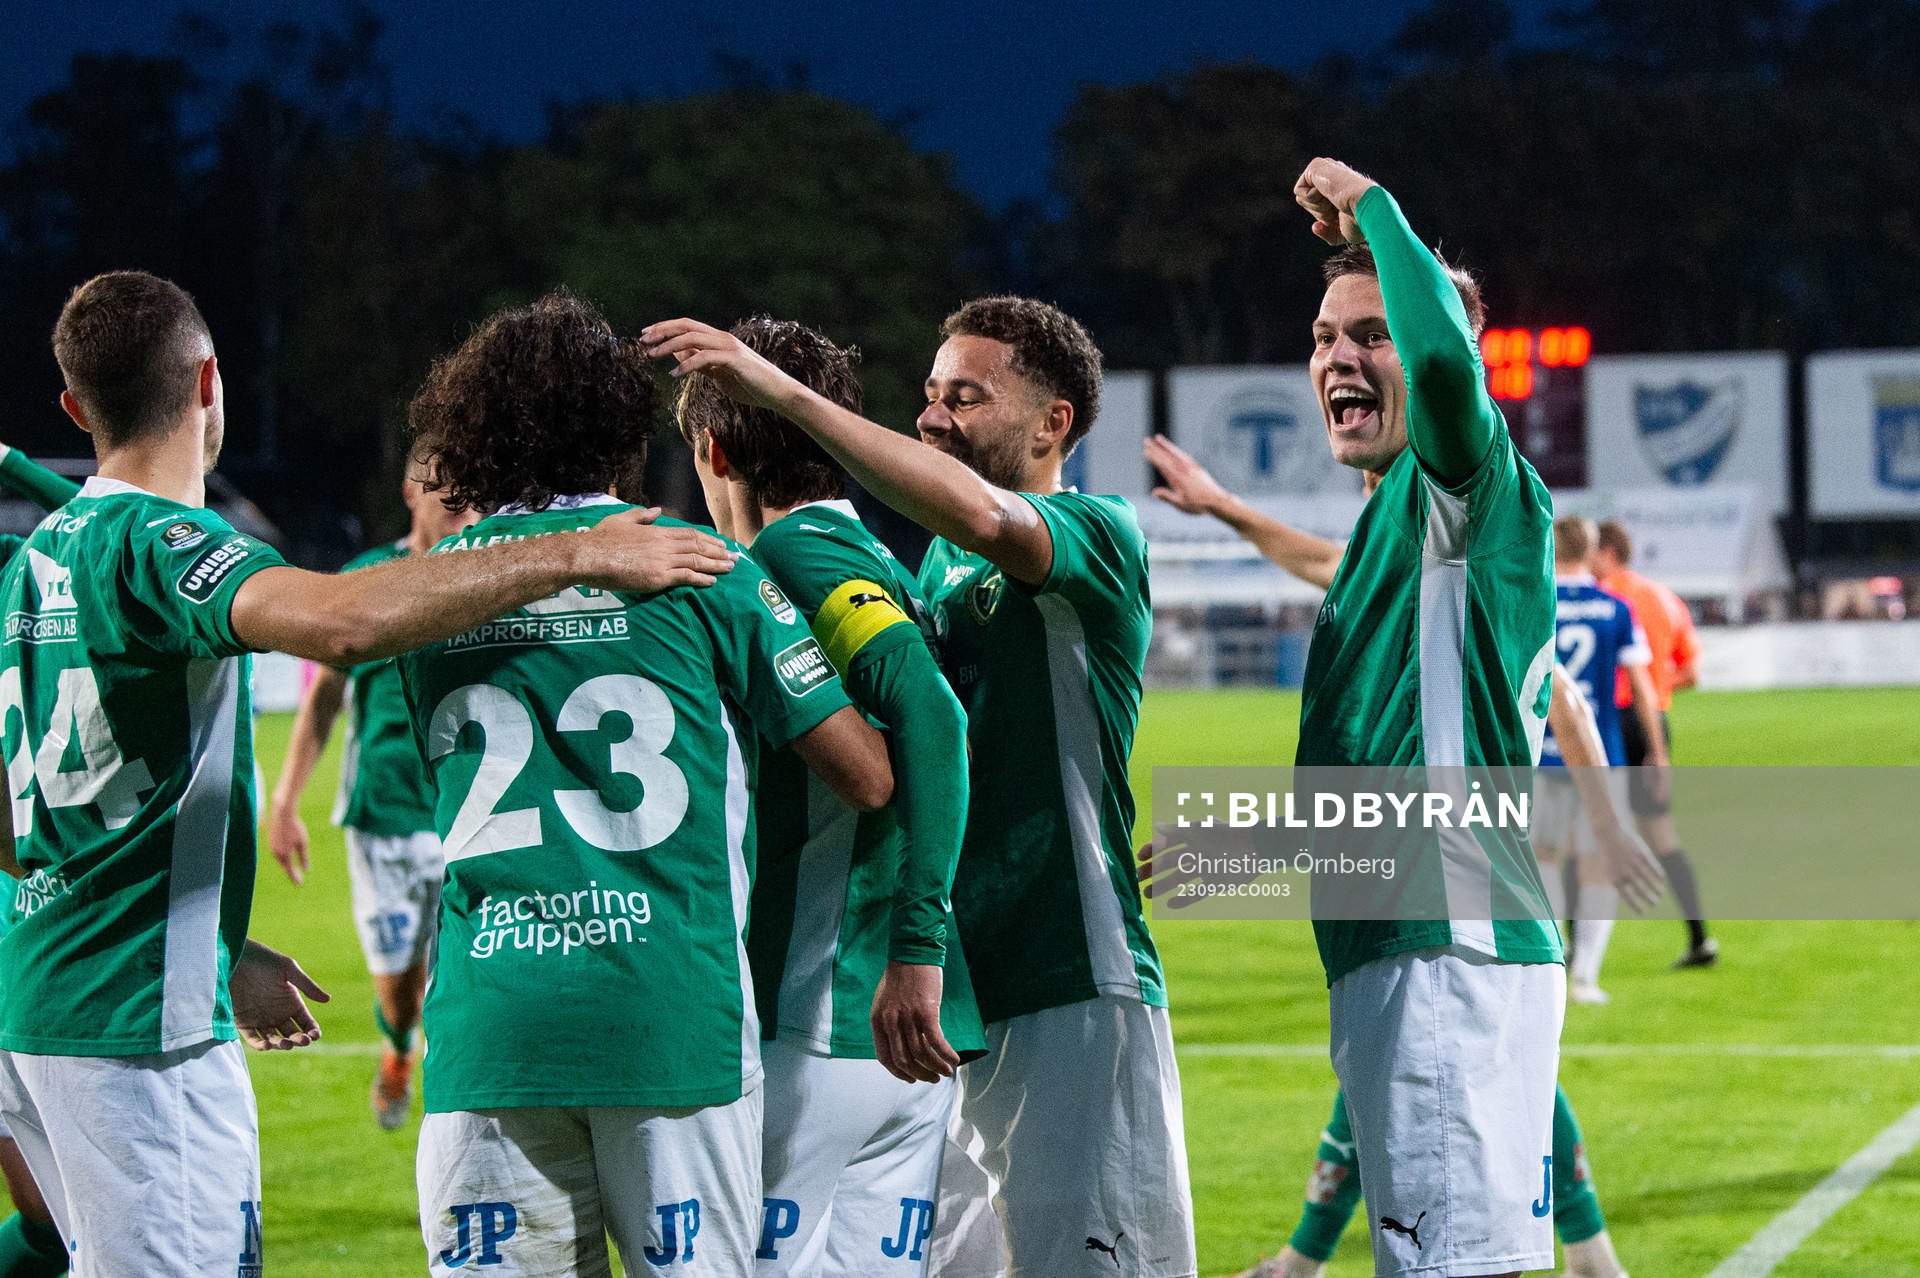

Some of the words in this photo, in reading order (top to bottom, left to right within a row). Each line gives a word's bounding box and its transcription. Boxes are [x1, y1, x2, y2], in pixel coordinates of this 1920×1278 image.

[185, 537, 249, 591] UNIBET
[63, 618, 77, 636] AB
[598, 617, 628, 635] AB
[779, 646, 825, 679] UNIBET
[428, 674, 689, 864] 23
[478, 880, 652, 930] factoring
[469, 917, 633, 959] gruppen
[440, 1201, 517, 1268] JP
[643, 1198, 700, 1266] JP
[881, 1197, 934, 1261] JP
